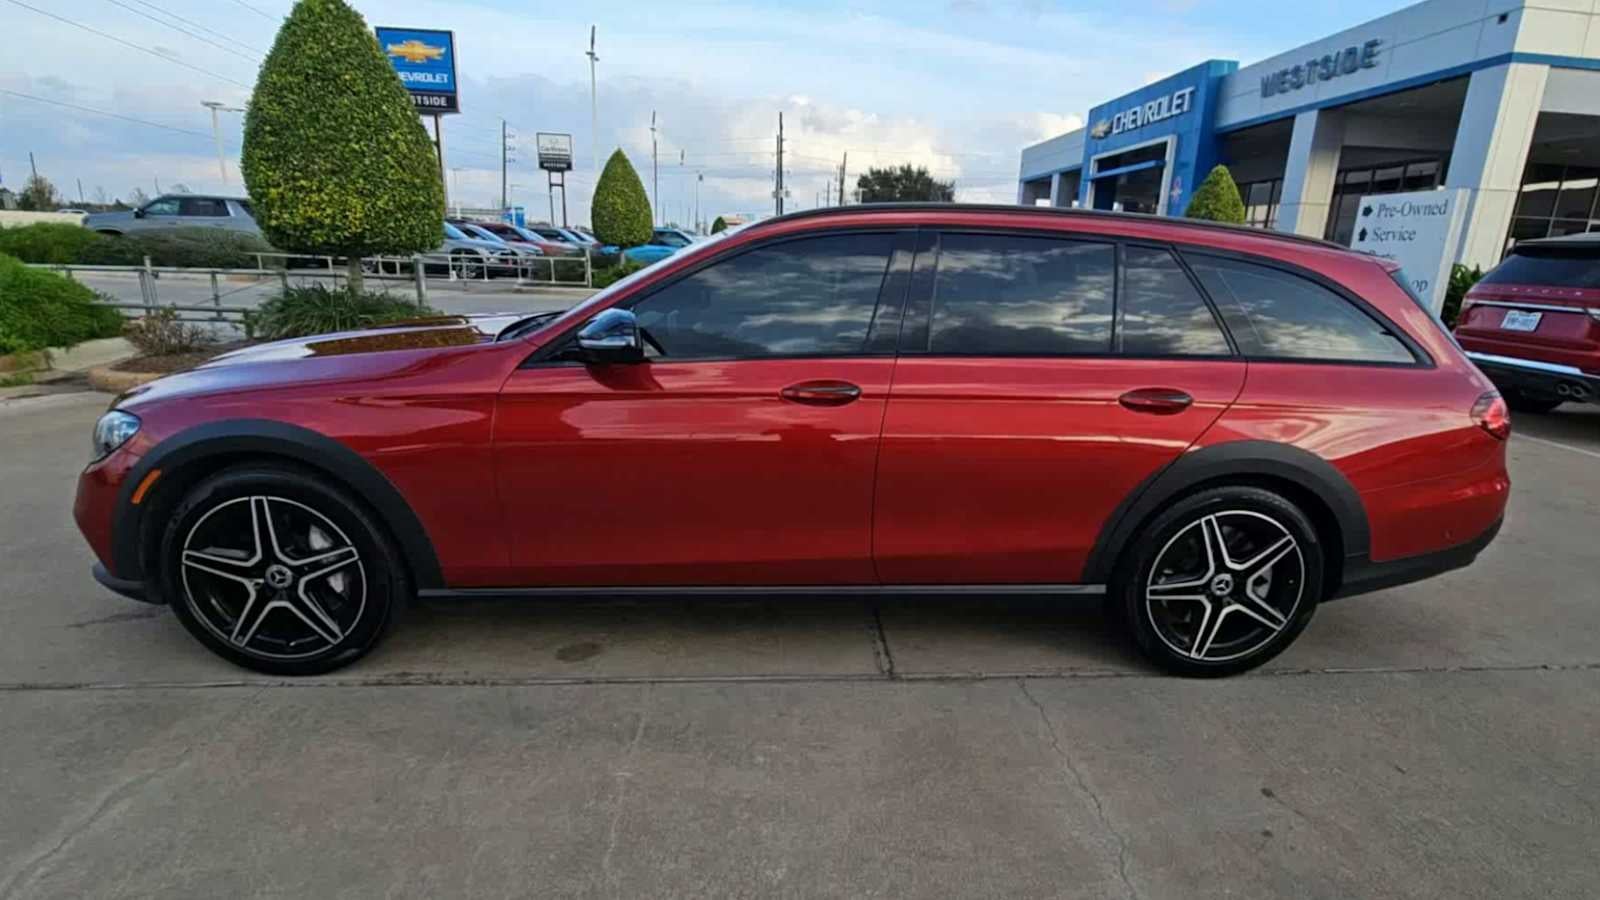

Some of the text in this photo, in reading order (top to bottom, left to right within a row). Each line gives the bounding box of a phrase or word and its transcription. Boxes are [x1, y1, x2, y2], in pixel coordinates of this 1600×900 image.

[1261, 39, 1381, 99] WESTSIDE
[1112, 86, 1196, 135] CHEVROLET
[1377, 198, 1449, 218] Pre-Owned
[1372, 225, 1417, 242] Service
